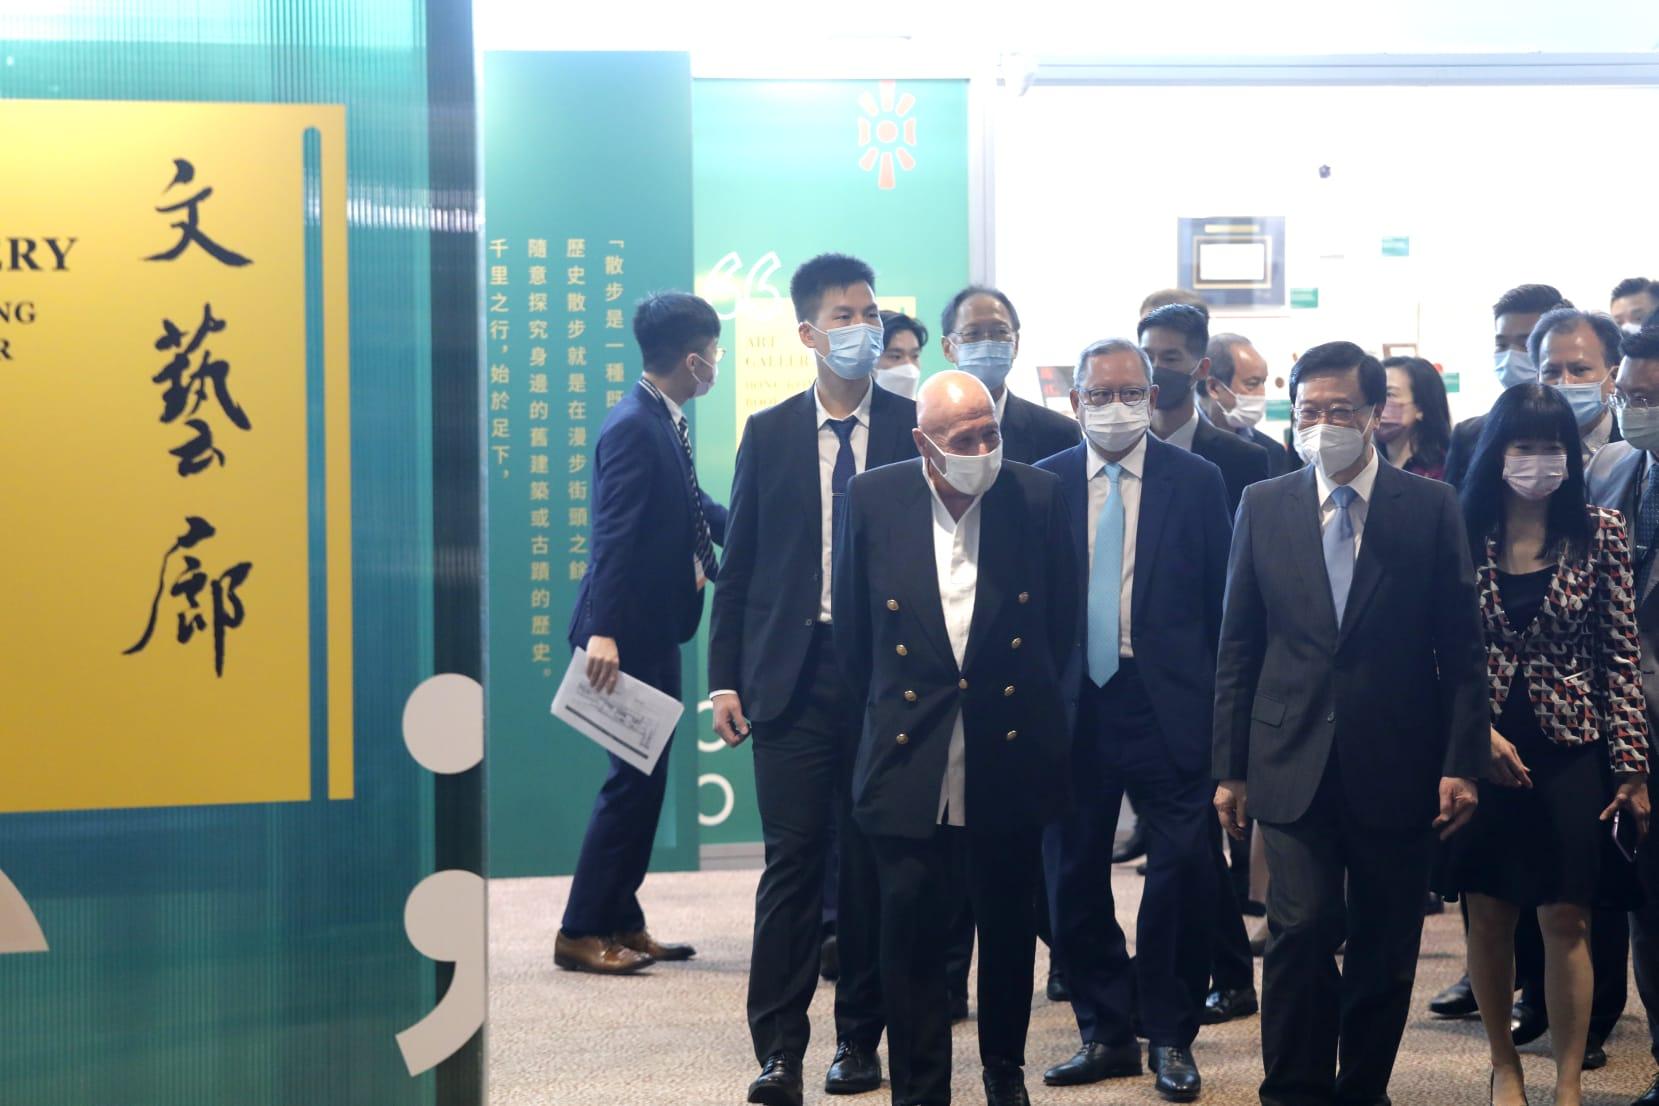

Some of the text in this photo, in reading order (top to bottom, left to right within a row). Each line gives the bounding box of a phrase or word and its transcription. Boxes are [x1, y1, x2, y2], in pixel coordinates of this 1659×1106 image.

[0, 237, 78, 272] RY
[122, 157, 254, 678] 文藝廊
